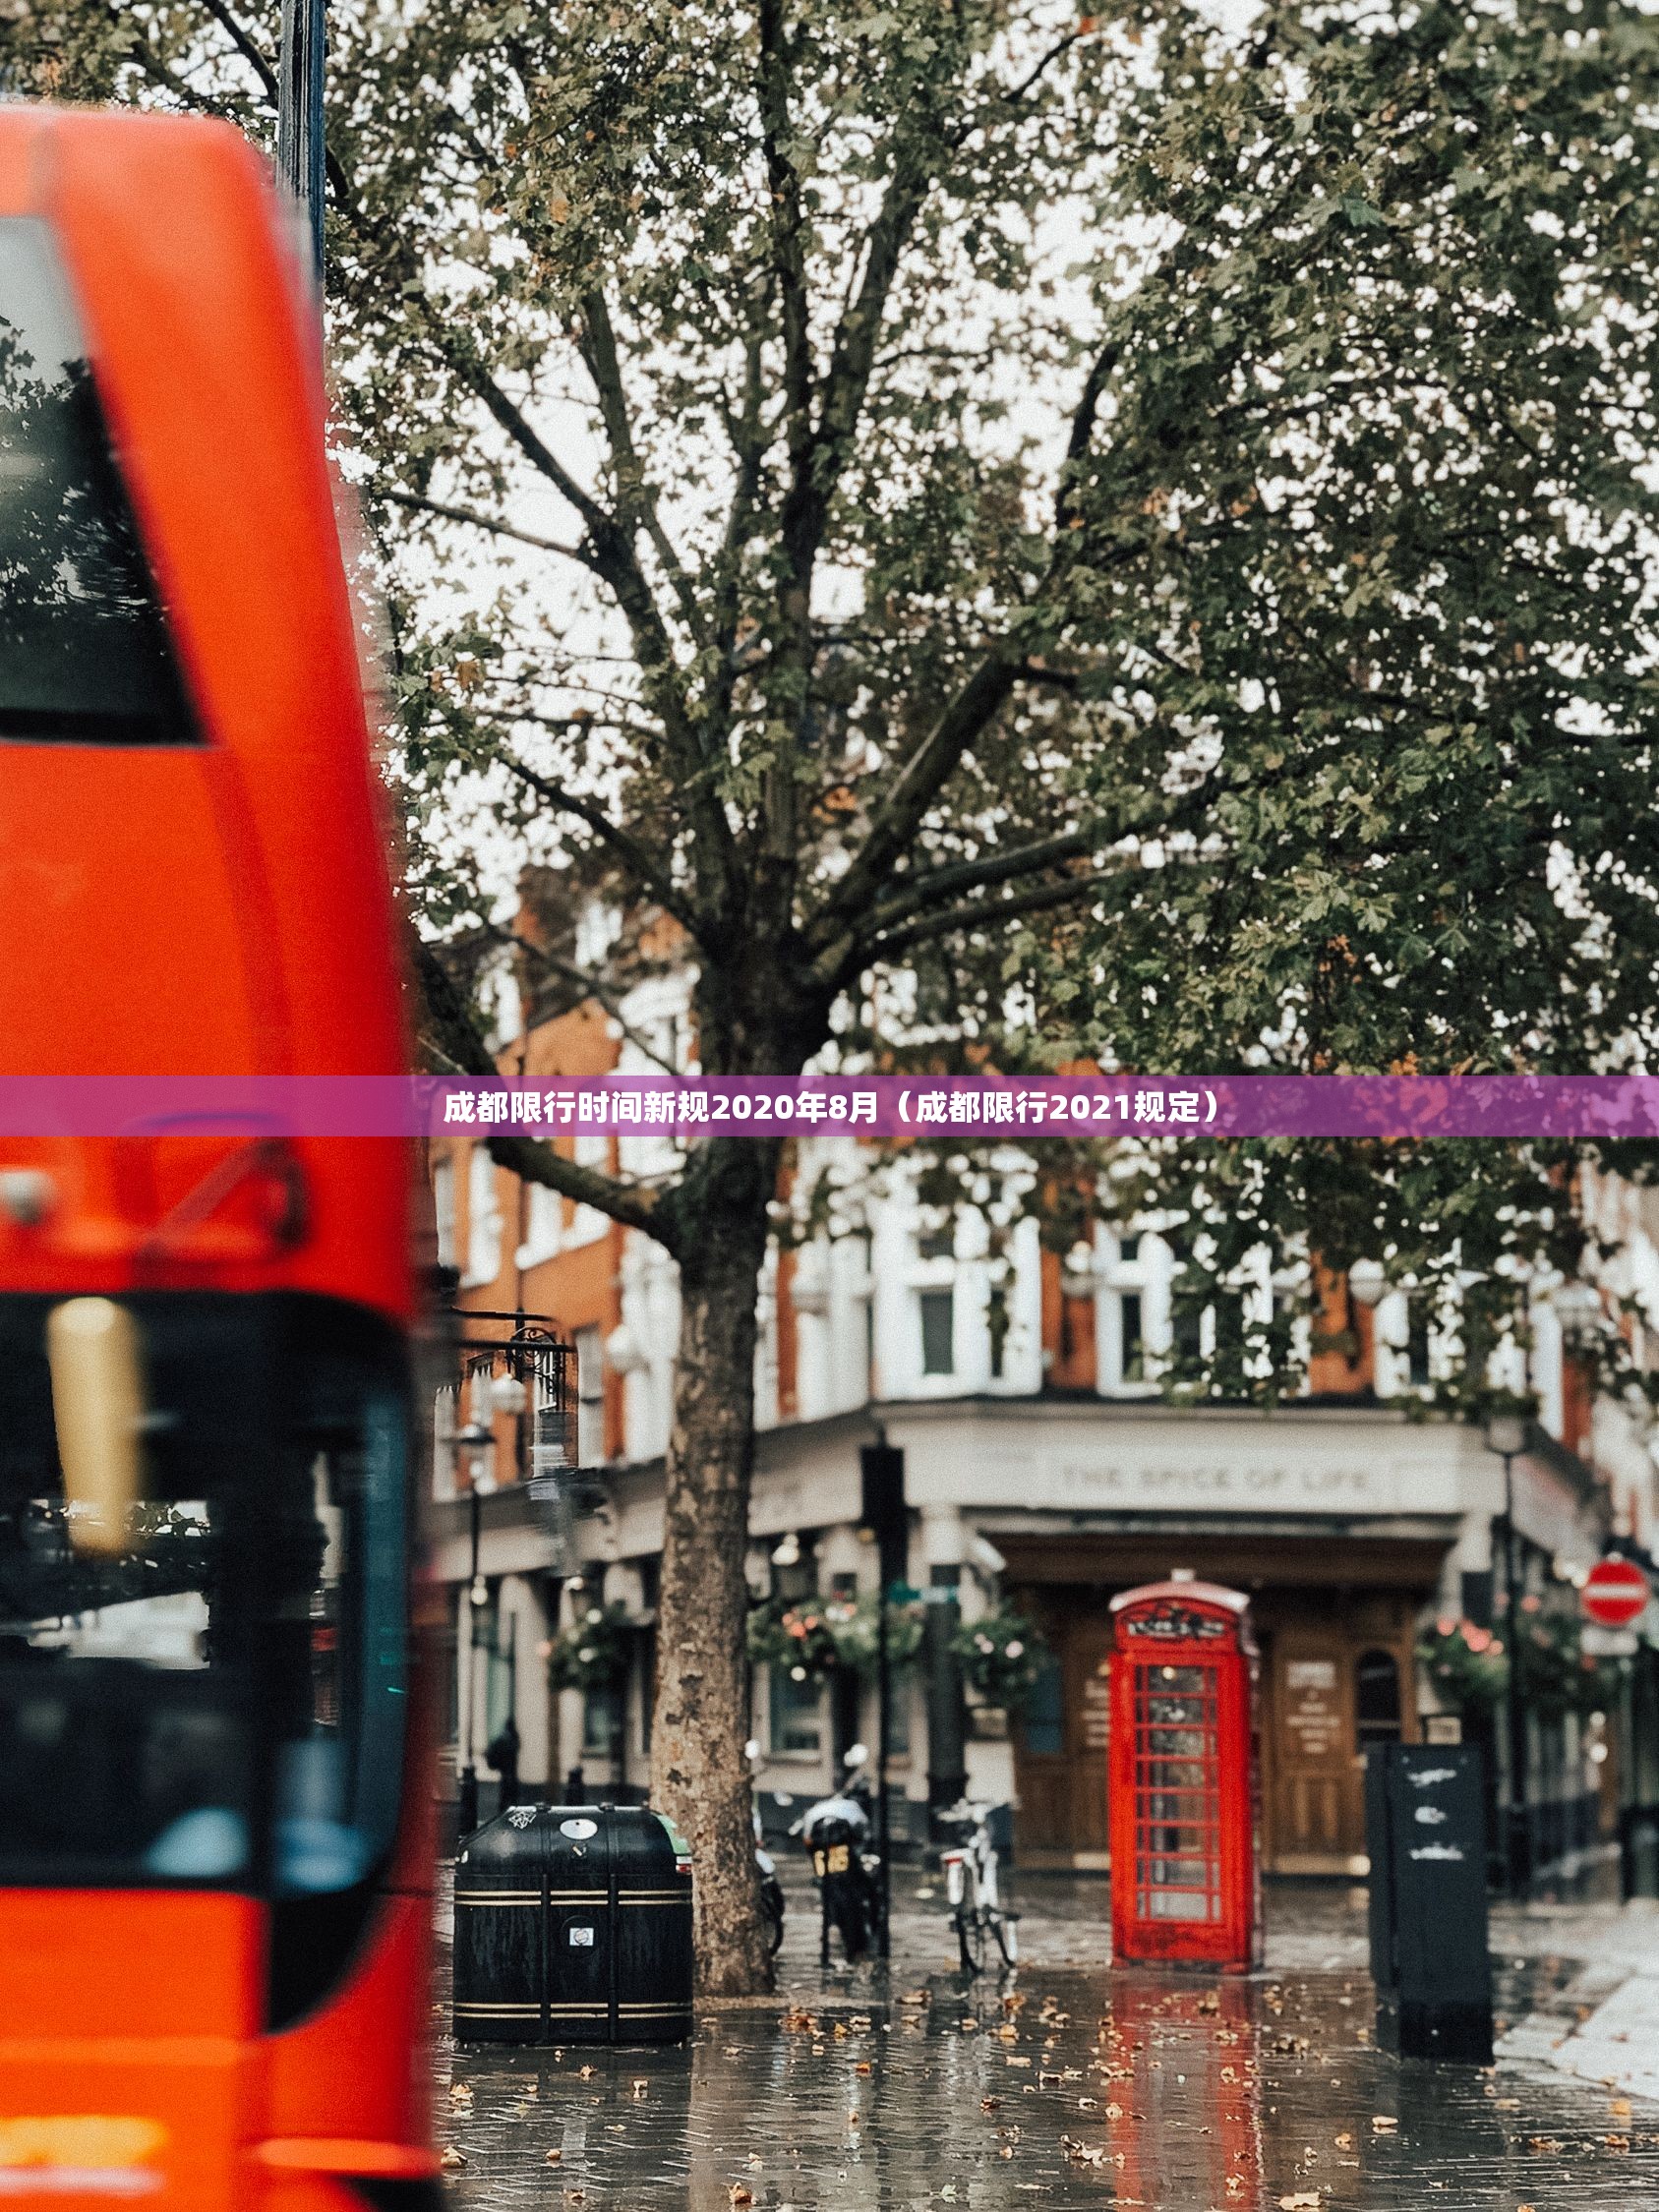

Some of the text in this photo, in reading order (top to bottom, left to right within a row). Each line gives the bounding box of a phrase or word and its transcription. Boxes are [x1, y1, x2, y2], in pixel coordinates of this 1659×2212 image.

[1062, 1465, 1371, 1491] THE SPICE OF LIFE
